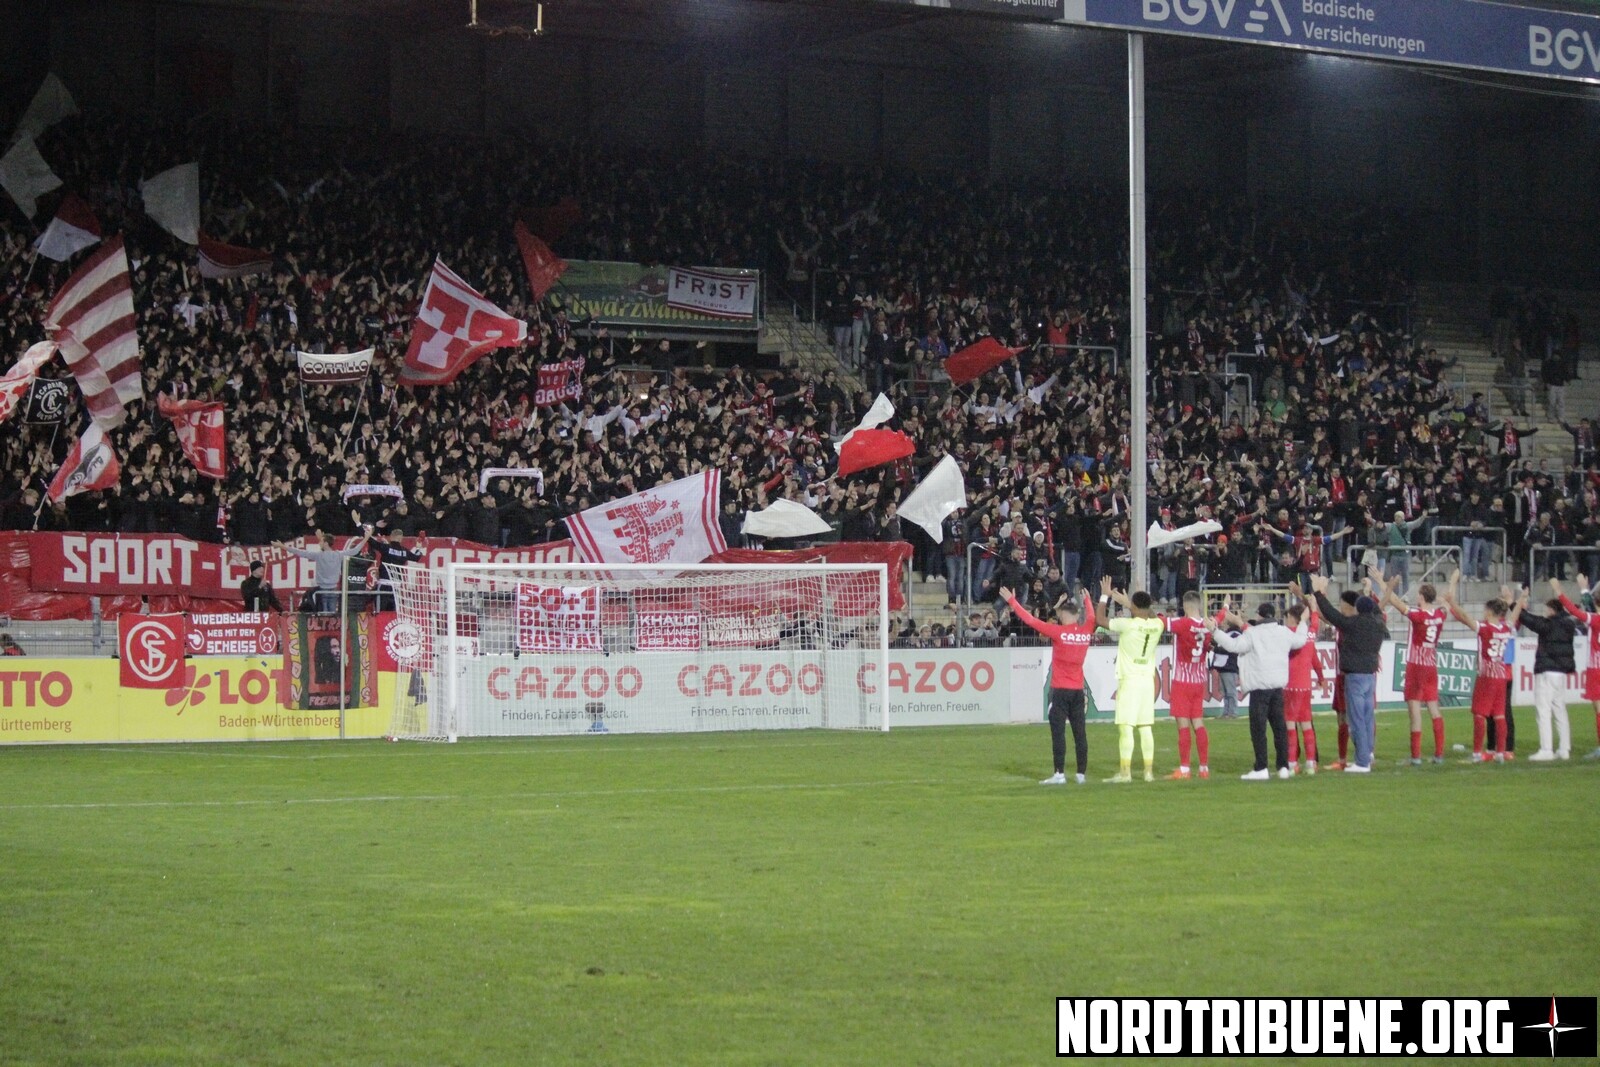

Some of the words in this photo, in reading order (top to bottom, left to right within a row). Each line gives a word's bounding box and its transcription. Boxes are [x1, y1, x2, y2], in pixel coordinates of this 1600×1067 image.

[1303, 0, 1375, 21] Badische
[1303, 21, 1425, 54] Versicherungen
[1529, 25, 1600, 72] BGV
[303, 360, 369, 374] CORRILLO
[519, 583, 597, 612] 50+1
[192, 613, 261, 625] VIDEOBEWEIS
[640, 615, 698, 626] KHALID
[207, 629, 223, 637] WEG
[225, 629, 237, 637] MIT
[239, 629, 256, 637] DEM
[665, 628, 699, 636] IMMER
[1061, 632, 1091, 642] CAZOO
[1425, 625, 1438, 643] 9
[206, 640, 257, 654] SCHEISS
[1141, 633, 1150, 657] 1
[1191, 632, 1205, 656] 3
[487, 666, 643, 700] CAZOO
[677, 663, 824, 698] CAZOO
[857, 660, 995, 694] CAZOO
[691, 705, 731, 717] Finden.
[732, 706, 771, 716] Fahren.
[773, 704, 811, 715] Freuen.
[908, 702, 945, 713] Fahren.
[947, 701, 983, 712] Freuen.
[219, 714, 341, 728] Baden-Württemberg
